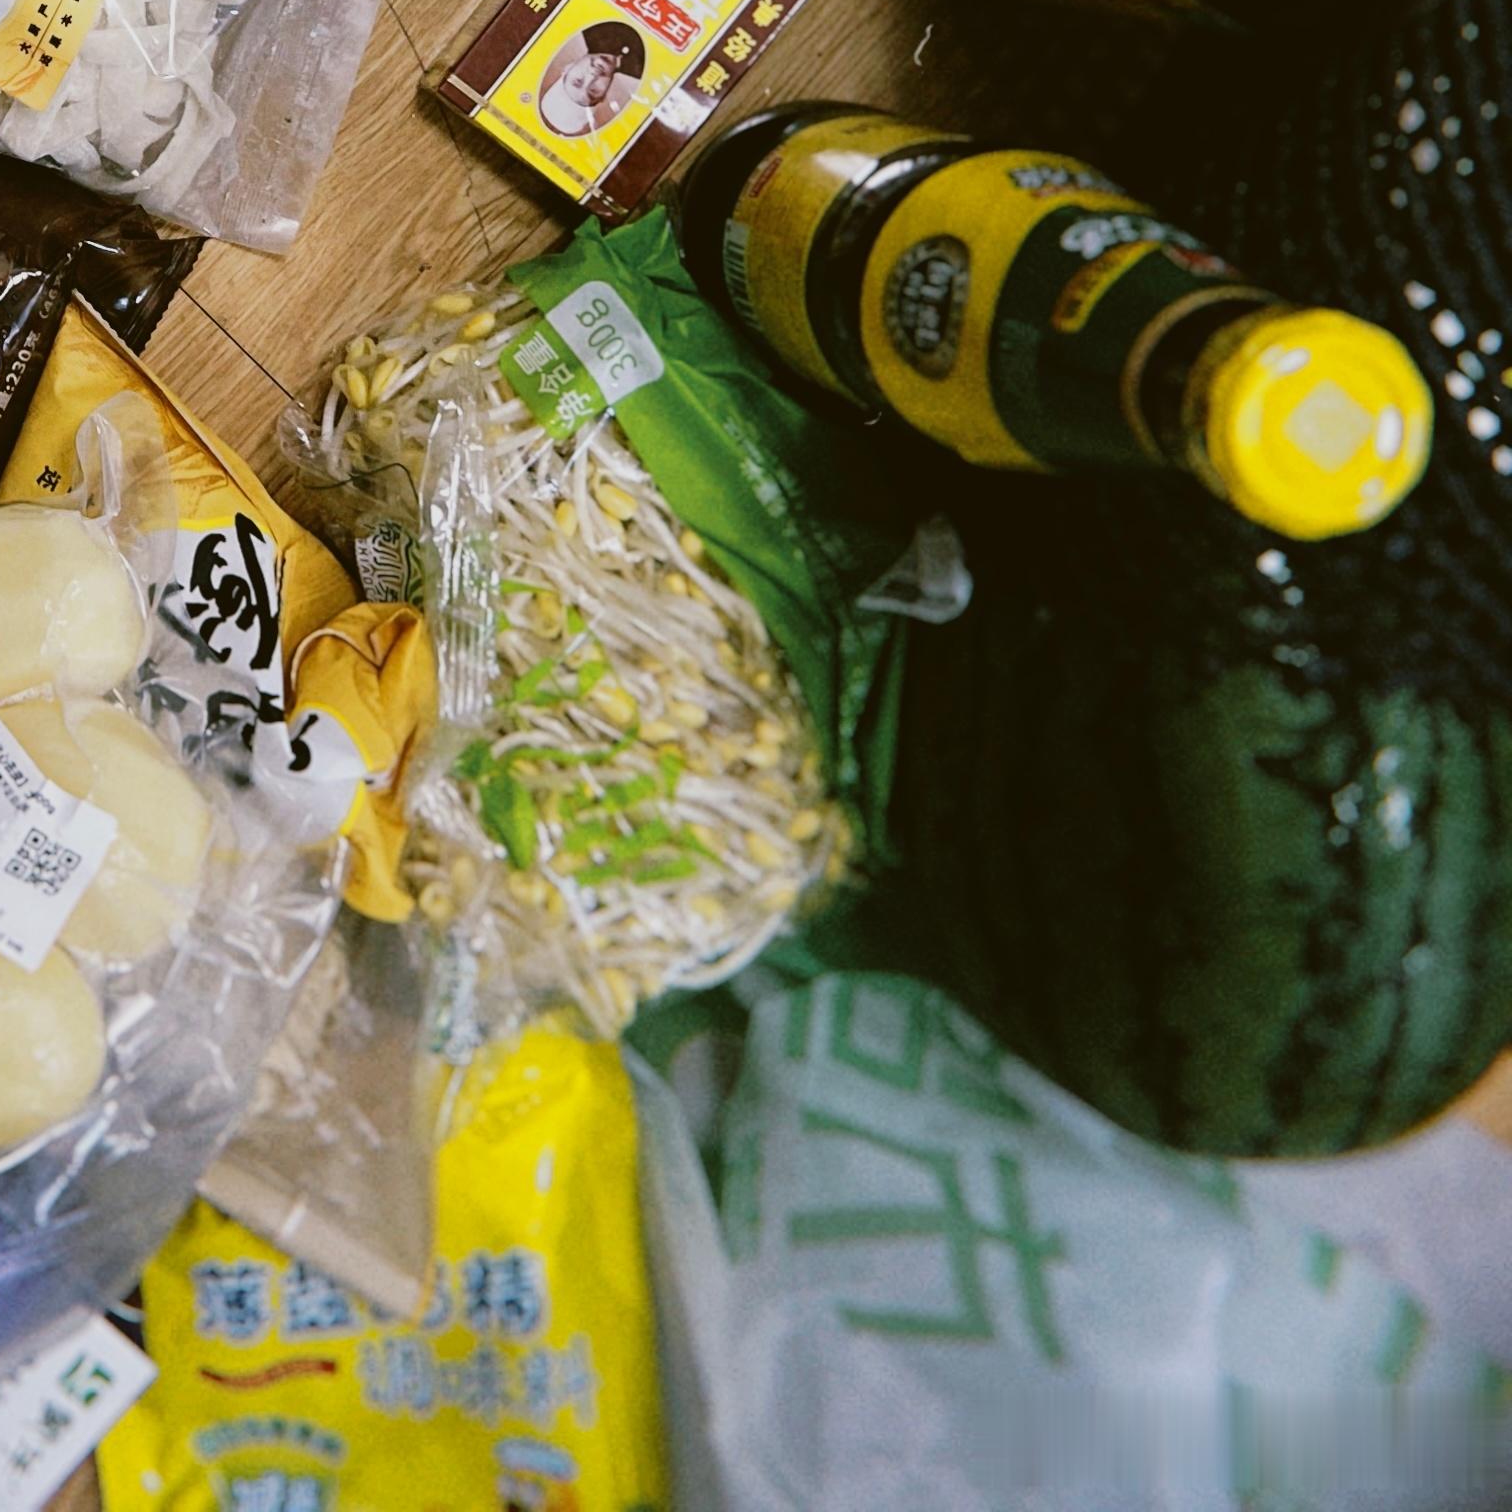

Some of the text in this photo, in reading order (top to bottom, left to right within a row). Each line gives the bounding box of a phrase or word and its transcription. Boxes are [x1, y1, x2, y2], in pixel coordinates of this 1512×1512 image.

[511, 329, 594, 432] 净含量
[574, 296, 641, 383] 300g
